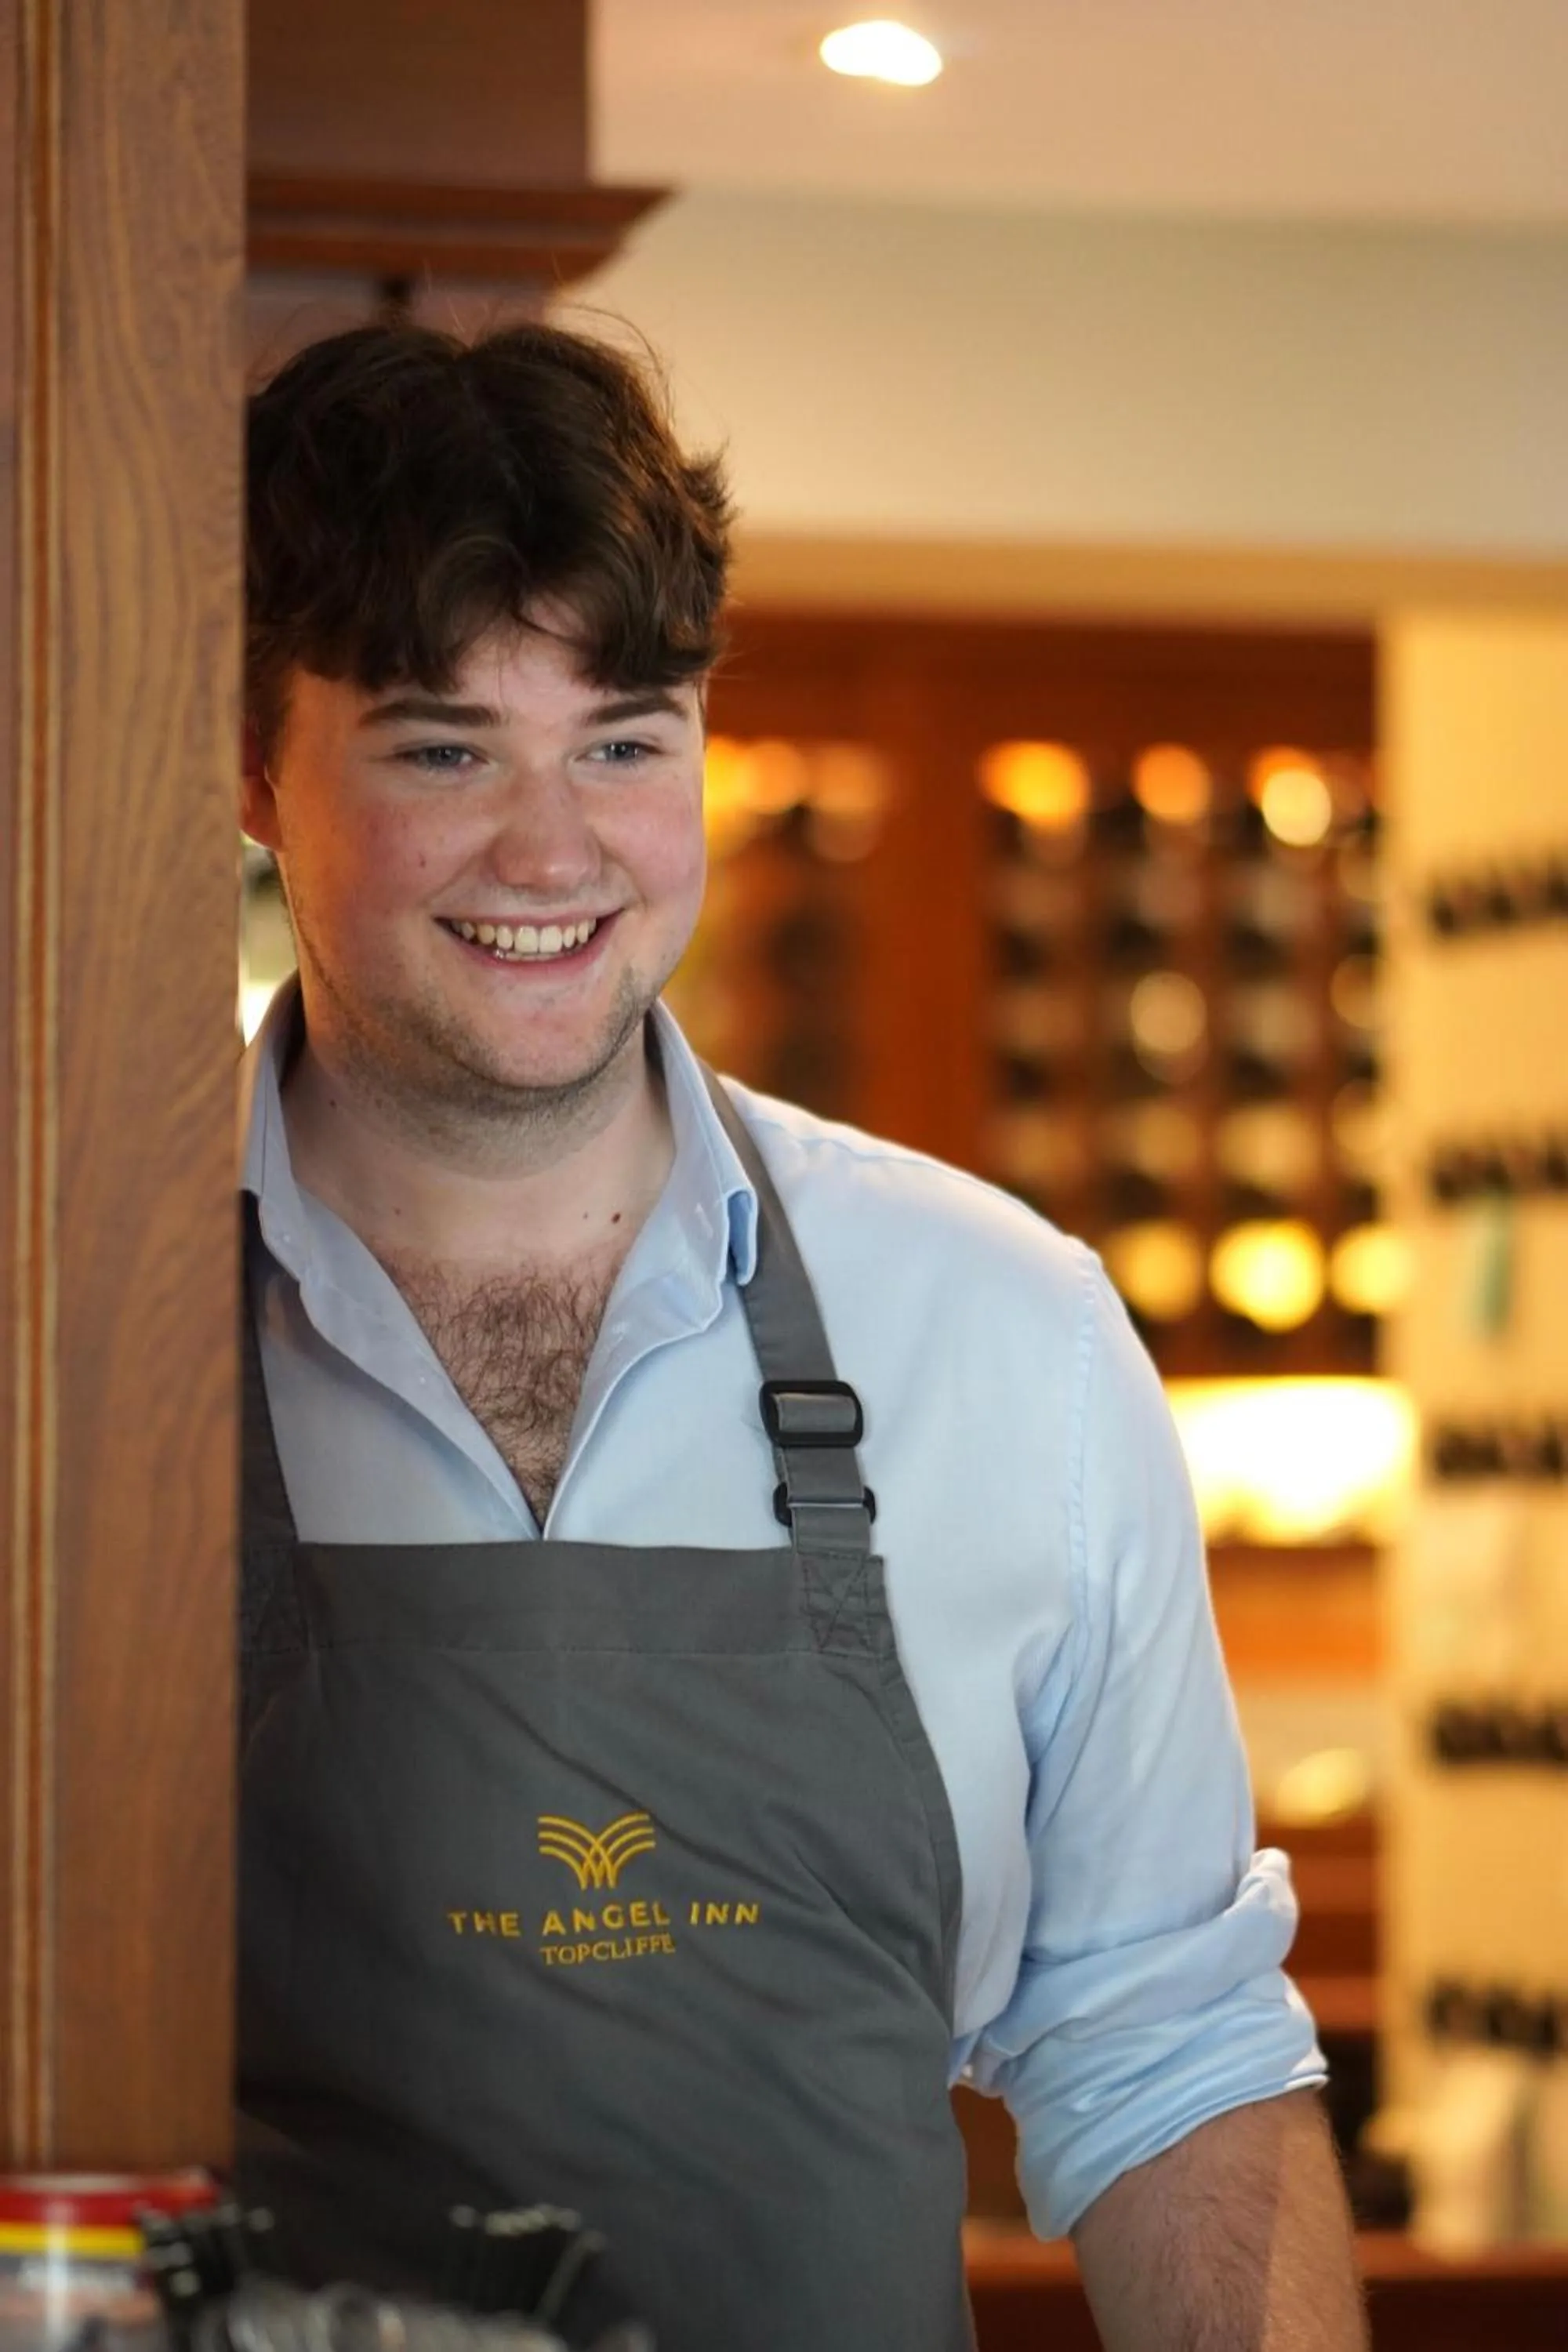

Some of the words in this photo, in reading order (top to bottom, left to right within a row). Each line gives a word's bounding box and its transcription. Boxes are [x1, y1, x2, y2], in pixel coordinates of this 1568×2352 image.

[448, 1911, 521, 1936] THE
[542, 1901, 671, 1936] ANGEL
[689, 1901, 760, 1926] INN
[540, 1933, 676, 1965] TOPCLIFFE
